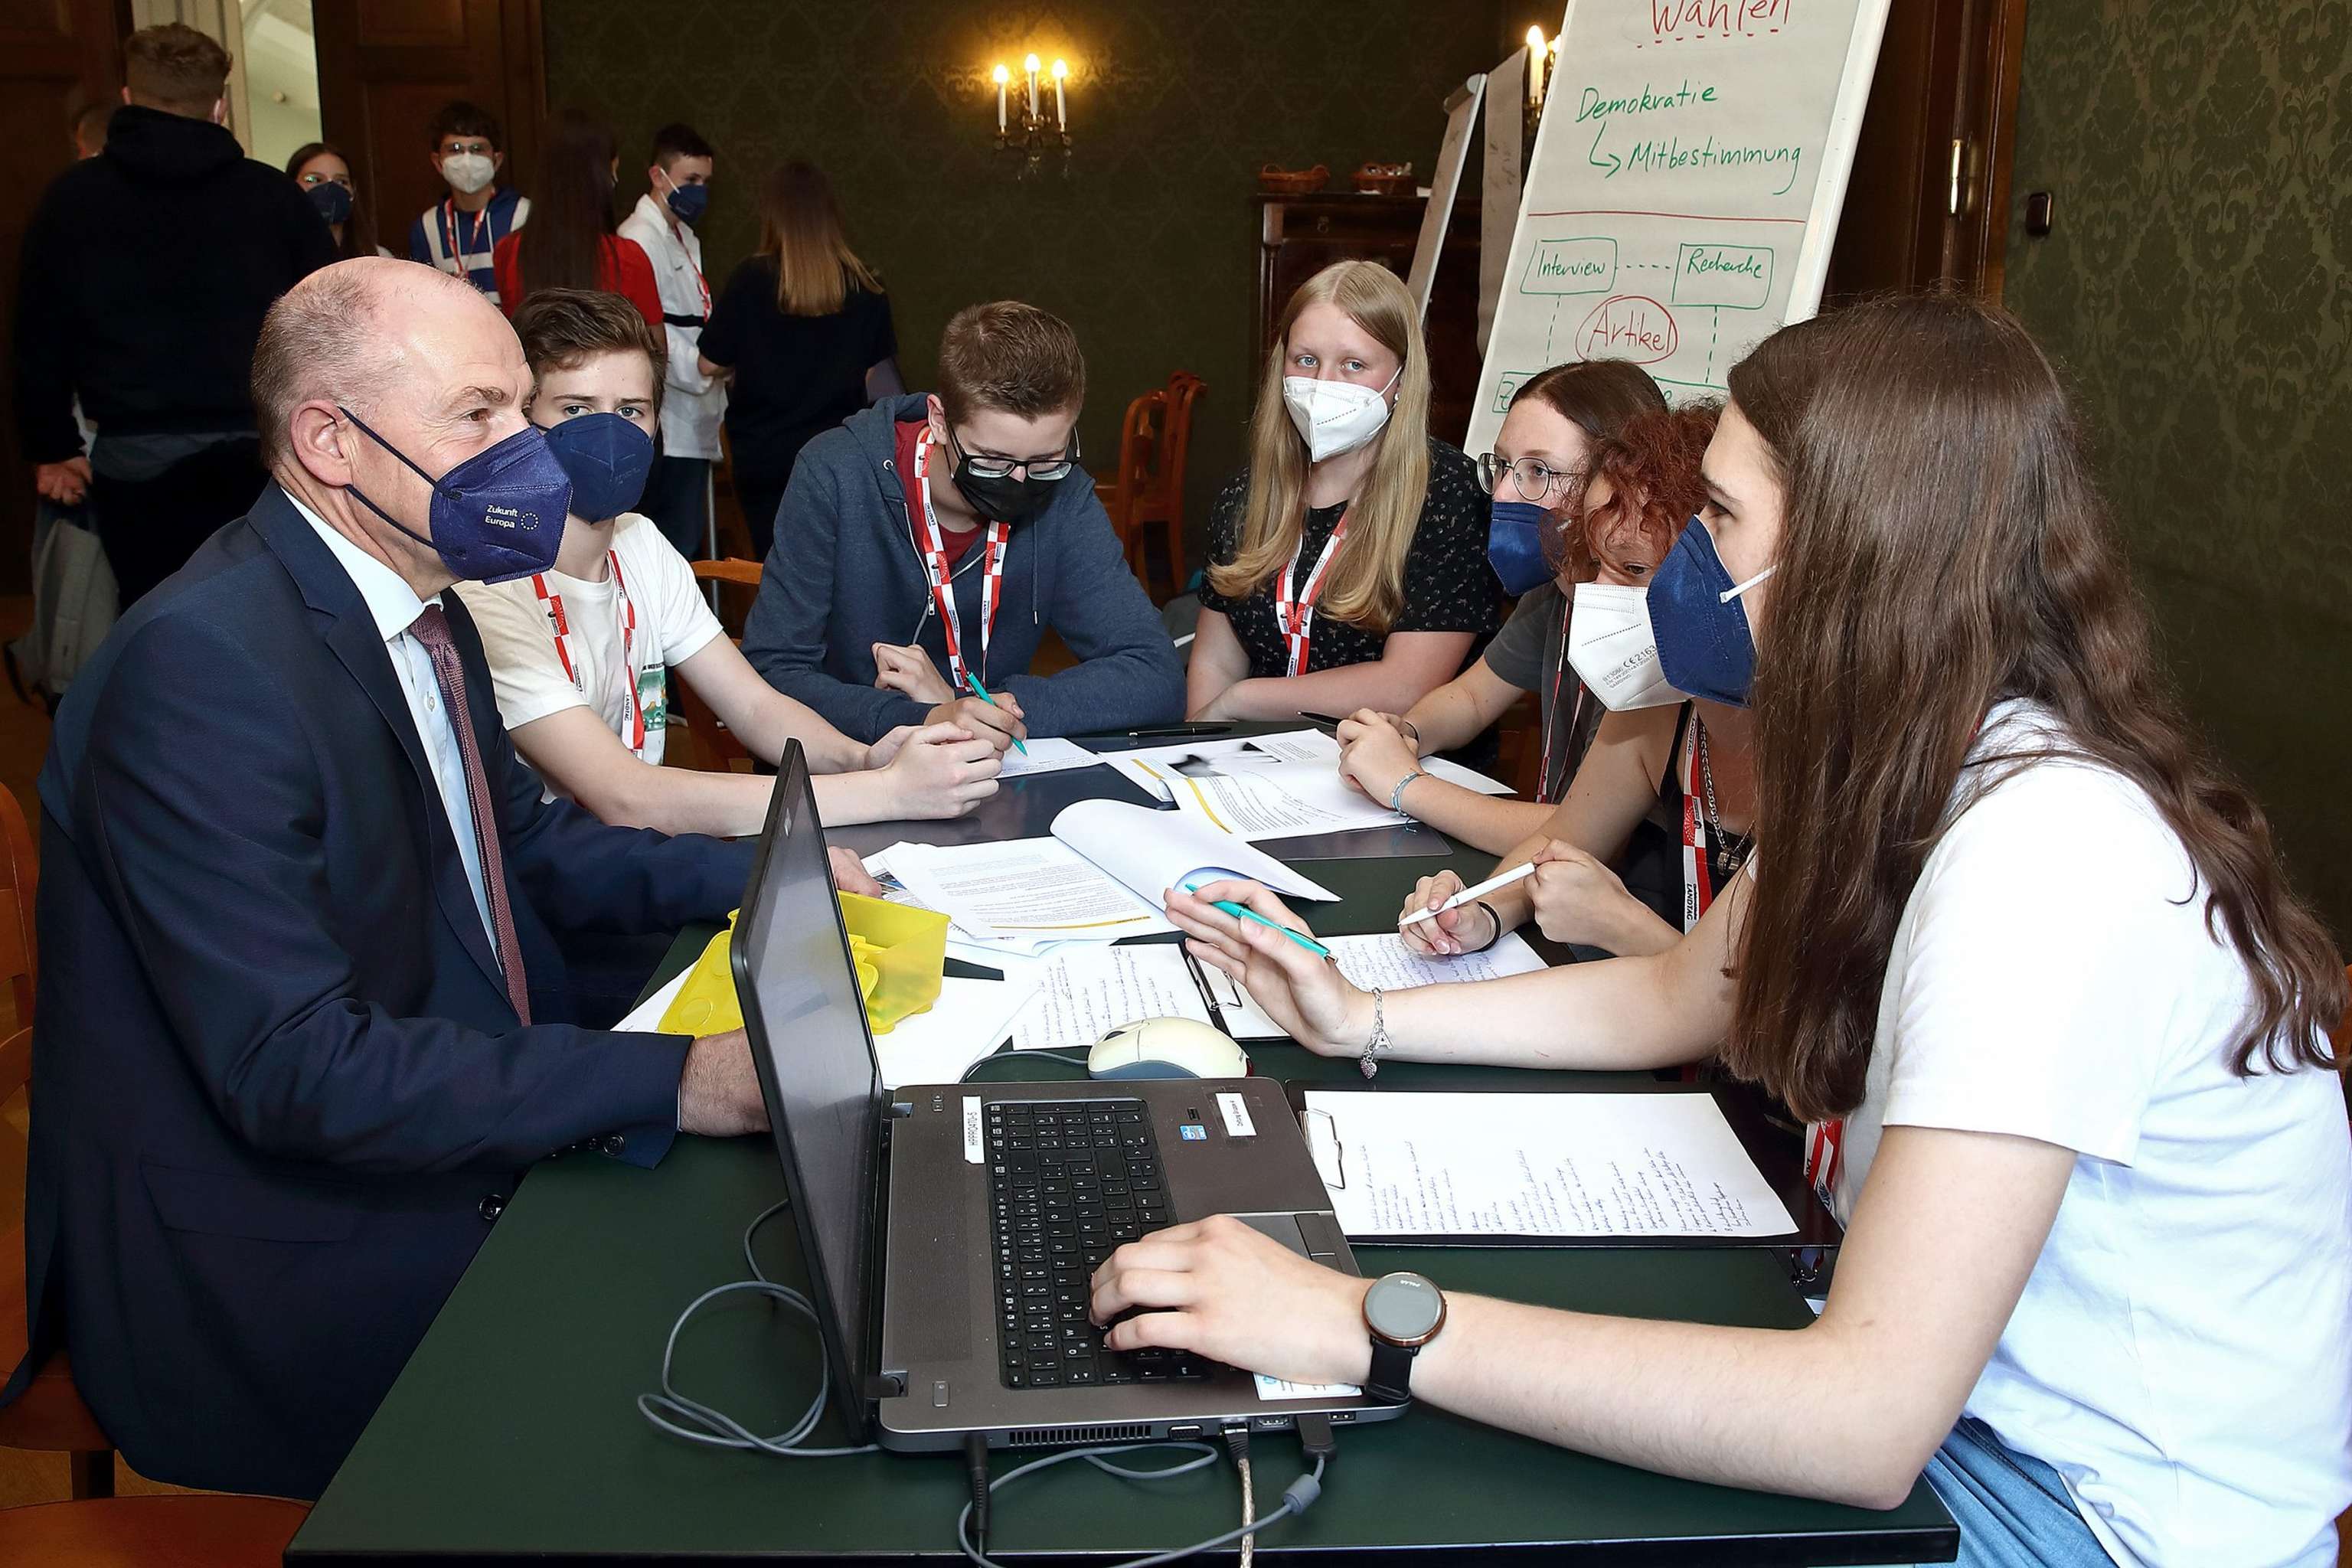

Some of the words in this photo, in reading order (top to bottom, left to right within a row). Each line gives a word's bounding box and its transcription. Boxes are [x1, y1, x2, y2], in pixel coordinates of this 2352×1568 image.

[1575, 80, 1718, 122] Demokratie
[1628, 136, 1801, 196] Mitbestimmung
[1536, 250, 1606, 278] Interview
[1586, 307, 1674, 353] Artikel
[485, 516, 516, 528] Europa
[486, 505, 518, 517] Zukunft
[1687, 717, 1696, 755] LANDTAG
